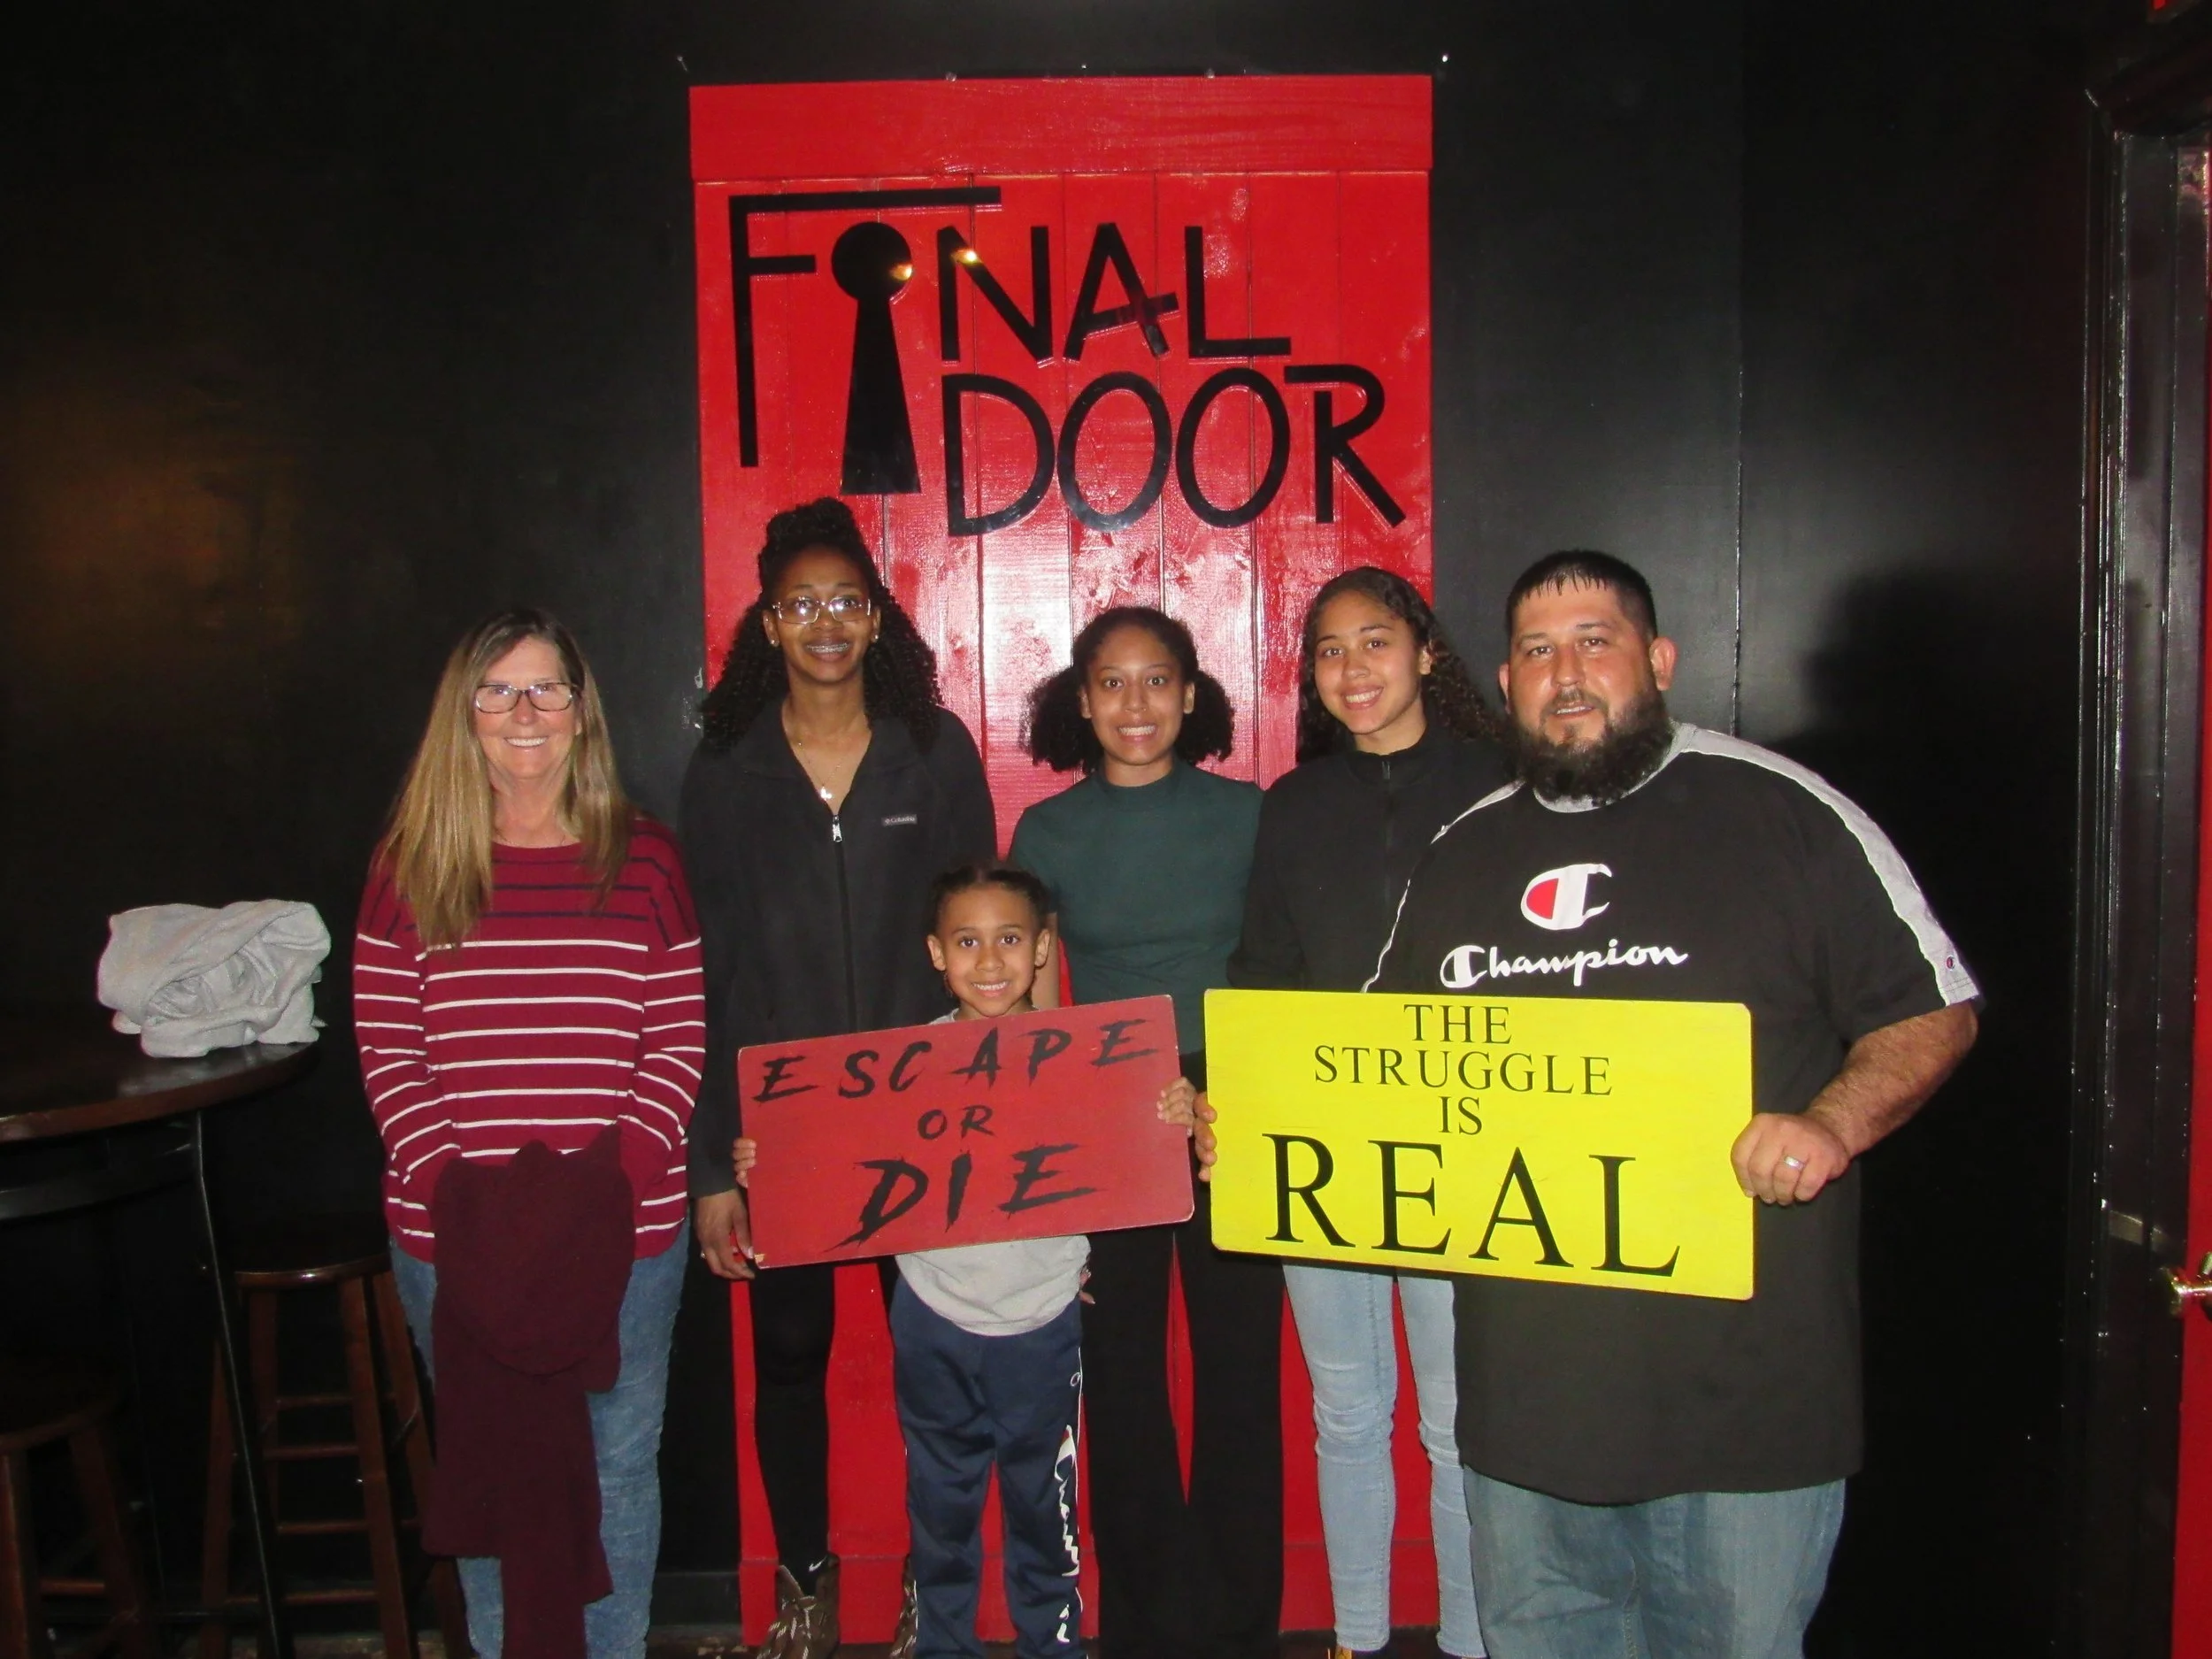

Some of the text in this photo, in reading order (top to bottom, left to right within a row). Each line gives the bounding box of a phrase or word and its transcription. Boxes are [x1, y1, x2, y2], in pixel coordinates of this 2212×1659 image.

[729, 187, 1291, 494] FINAL
[941, 365, 1405, 535] DOOR
[1440, 939, 1688, 988] Champion
[1404, 1003, 1512, 1044] THE
[752, 1019, 1157, 1103] ESCAPE
[1314, 1045, 1613, 1096] STRUGGLE
[918, 1104, 995, 1140] OR
[1439, 1096, 1483, 1135] IS
[823, 1144, 1106, 1252] DIE
[1262, 1133, 1681, 1278] REAL
